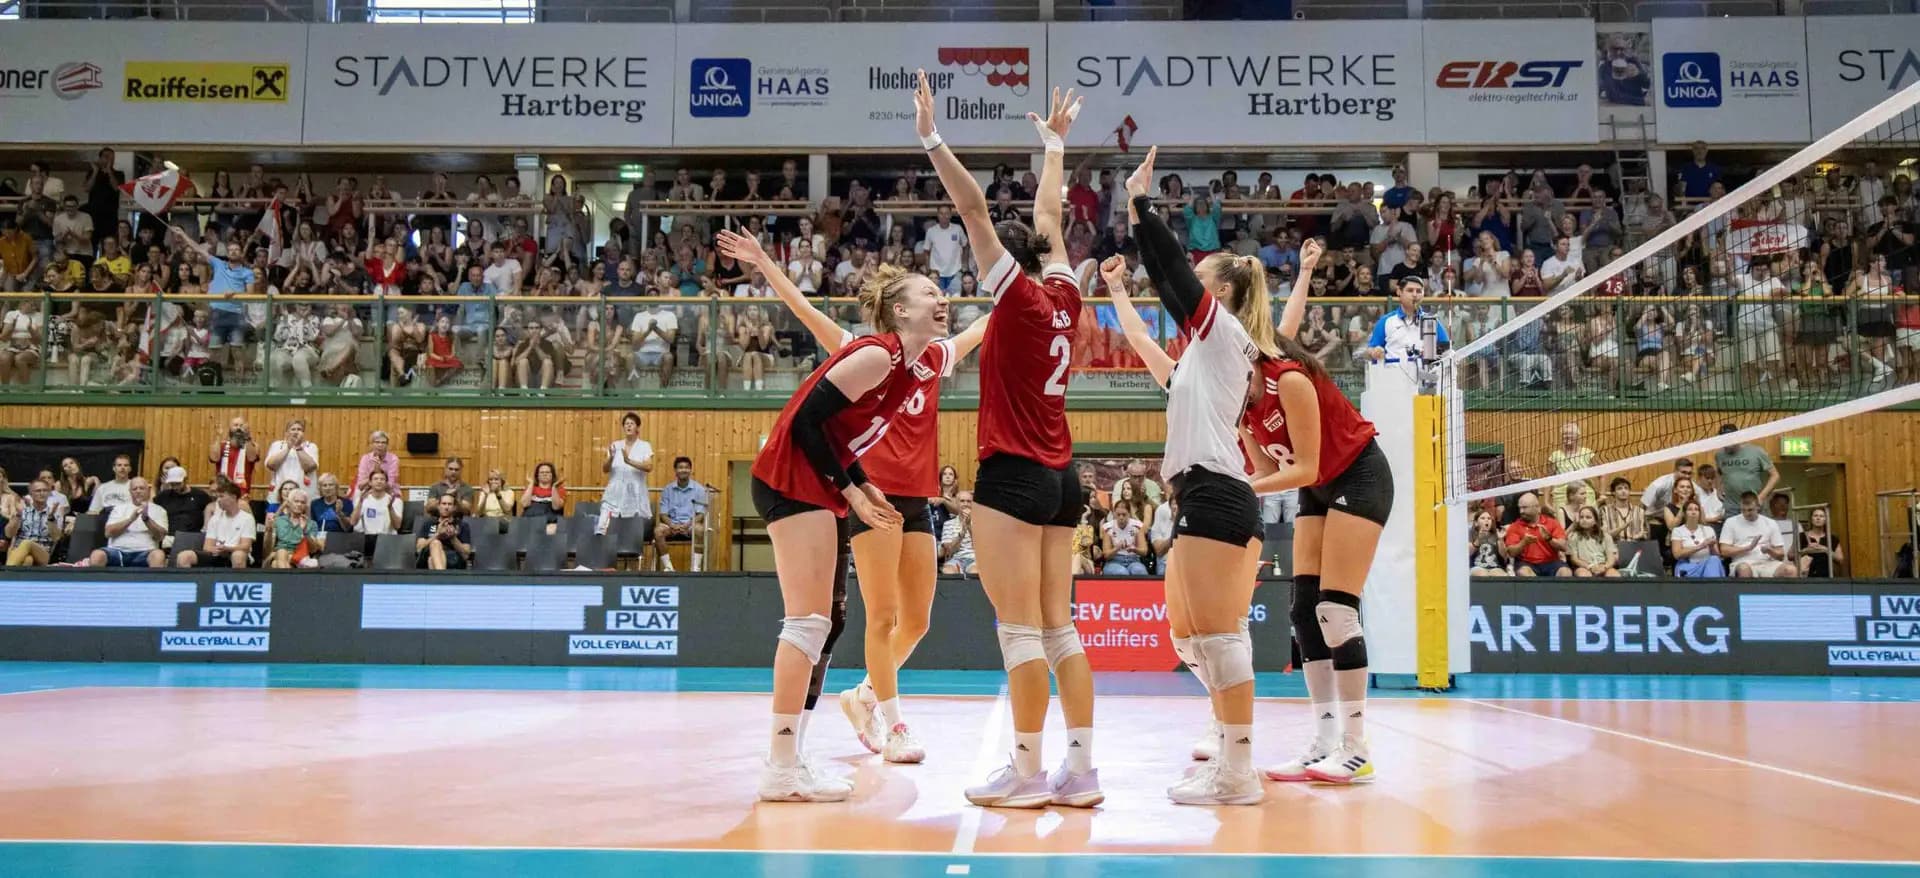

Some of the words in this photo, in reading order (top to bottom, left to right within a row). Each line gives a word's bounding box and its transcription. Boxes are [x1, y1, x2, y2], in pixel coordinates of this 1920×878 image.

[334, 55, 648, 96] STADTWERKE
[869, 66, 955, 95] Hocheger
[1076, 55, 1396, 96] STADTWERKE
[1730, 70, 1799, 88] HAAS
[127, 78, 250, 99] Raiffeisen
[758, 77, 829, 95] HAAS
[1667, 85, 1718, 99] UNIQA
[501, 94, 646, 123] Hartberg
[691, 93, 743, 107] UNIQA
[946, 96, 1005, 120] Dächer
[1248, 93, 1396, 121] Hartberg
[1044, 335, 1071, 396] 2
[223, 584, 264, 601] WE
[629, 588, 671, 604] WE
[208, 608, 270, 625] PLAY
[615, 612, 677, 629] PLAY
[1109, 603, 1169, 622] EuroV
[165, 636, 266, 646] VOLLEYBALL.AT
[572, 639, 673, 650] VOLLEYBALL.AT
[1079, 628, 1159, 648] ualifiers
